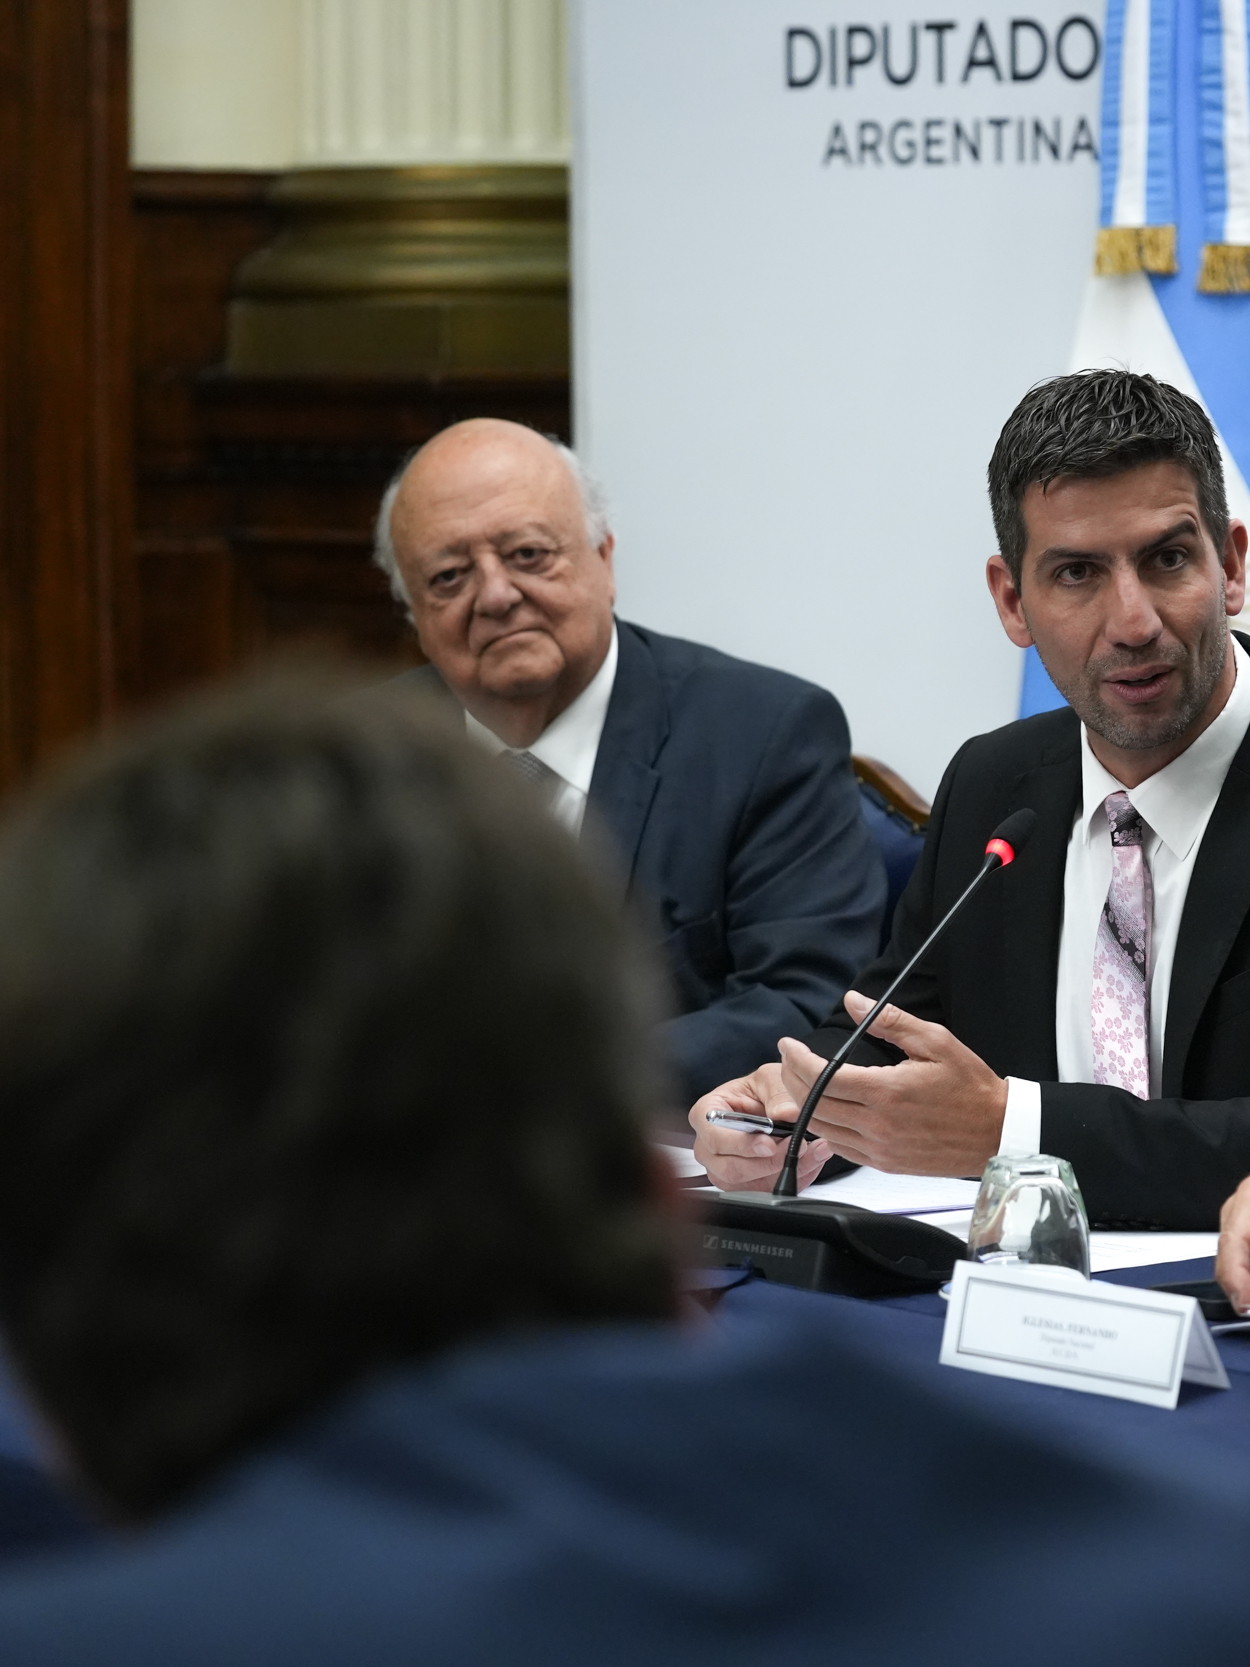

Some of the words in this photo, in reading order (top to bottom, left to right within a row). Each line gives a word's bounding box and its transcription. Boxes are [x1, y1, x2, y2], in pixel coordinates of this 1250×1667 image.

[785, 15, 1099, 88] DIPUTADO
[822, 116, 1099, 167] ARGENTINA
[721, 1239, 794, 1258] SENNHEISER
